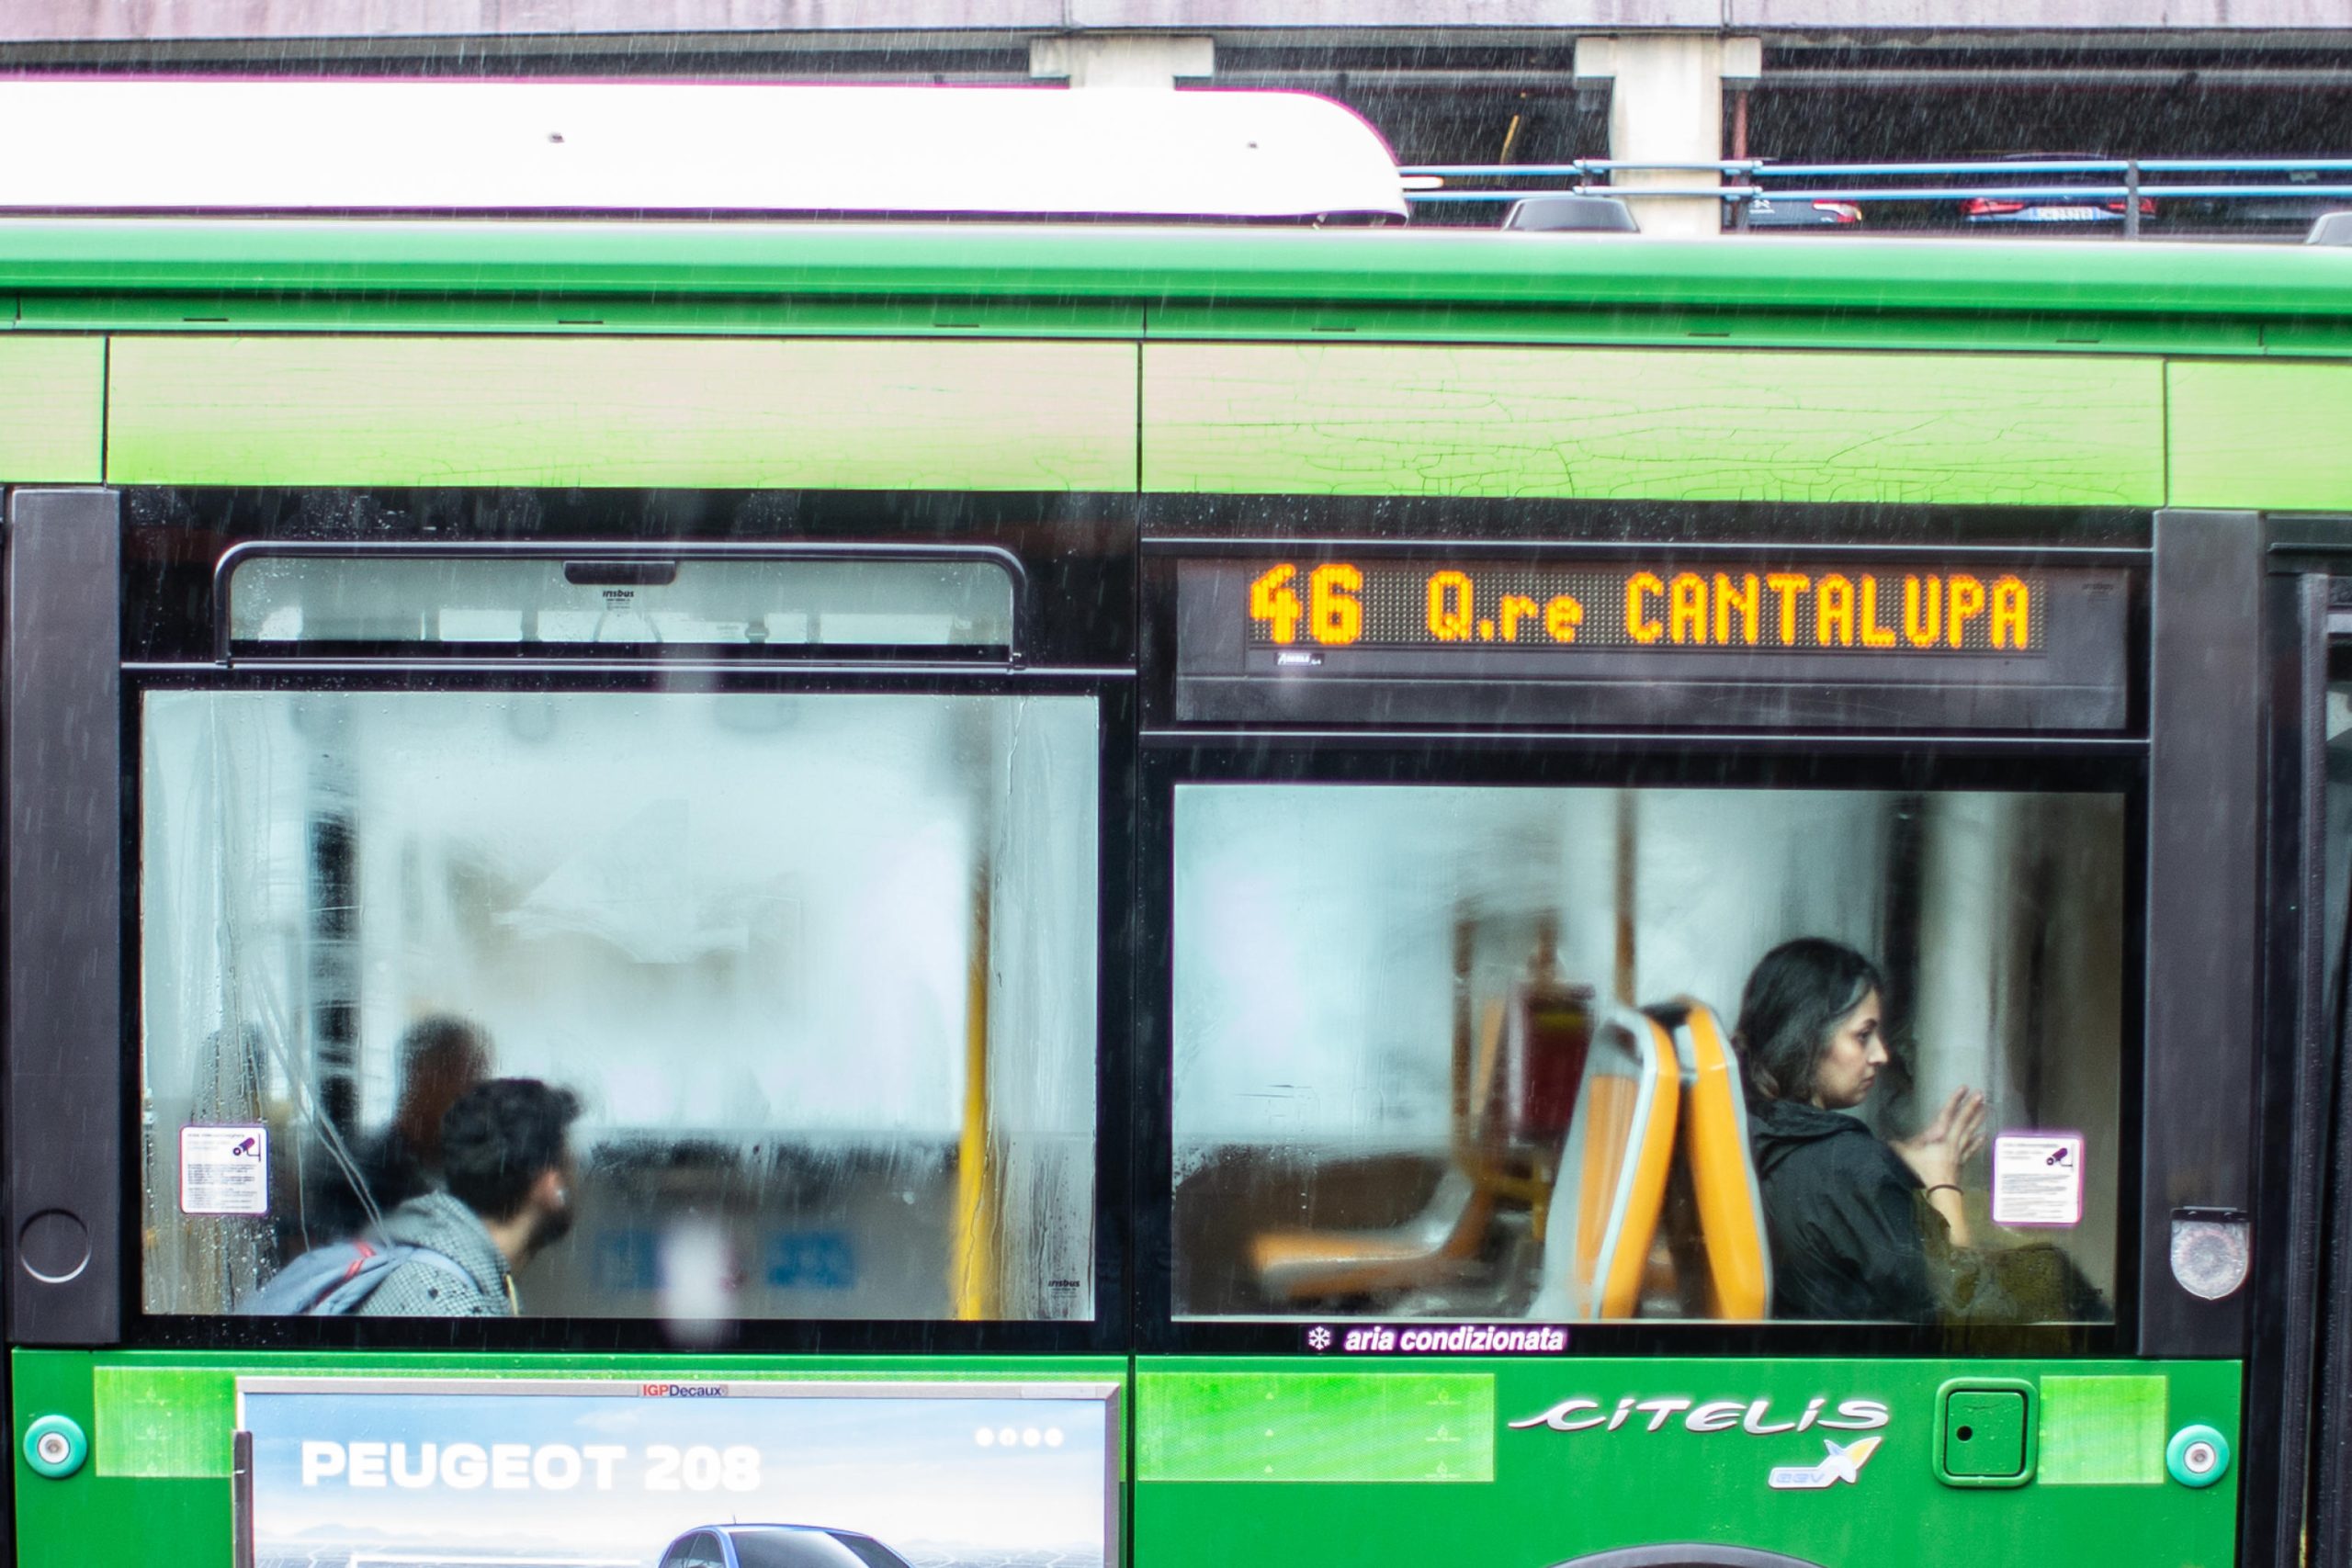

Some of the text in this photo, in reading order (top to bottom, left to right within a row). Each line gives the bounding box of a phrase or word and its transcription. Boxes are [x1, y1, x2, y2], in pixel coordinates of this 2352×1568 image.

[1250, 563, 2029, 649] 46 Q.re CANTALUPA
[1344, 1325, 1565, 1351] aria condizionata
[643, 1384, 721, 1397] IGPDecaux
[301, 1440, 762, 1493] PEUGEOT 208
